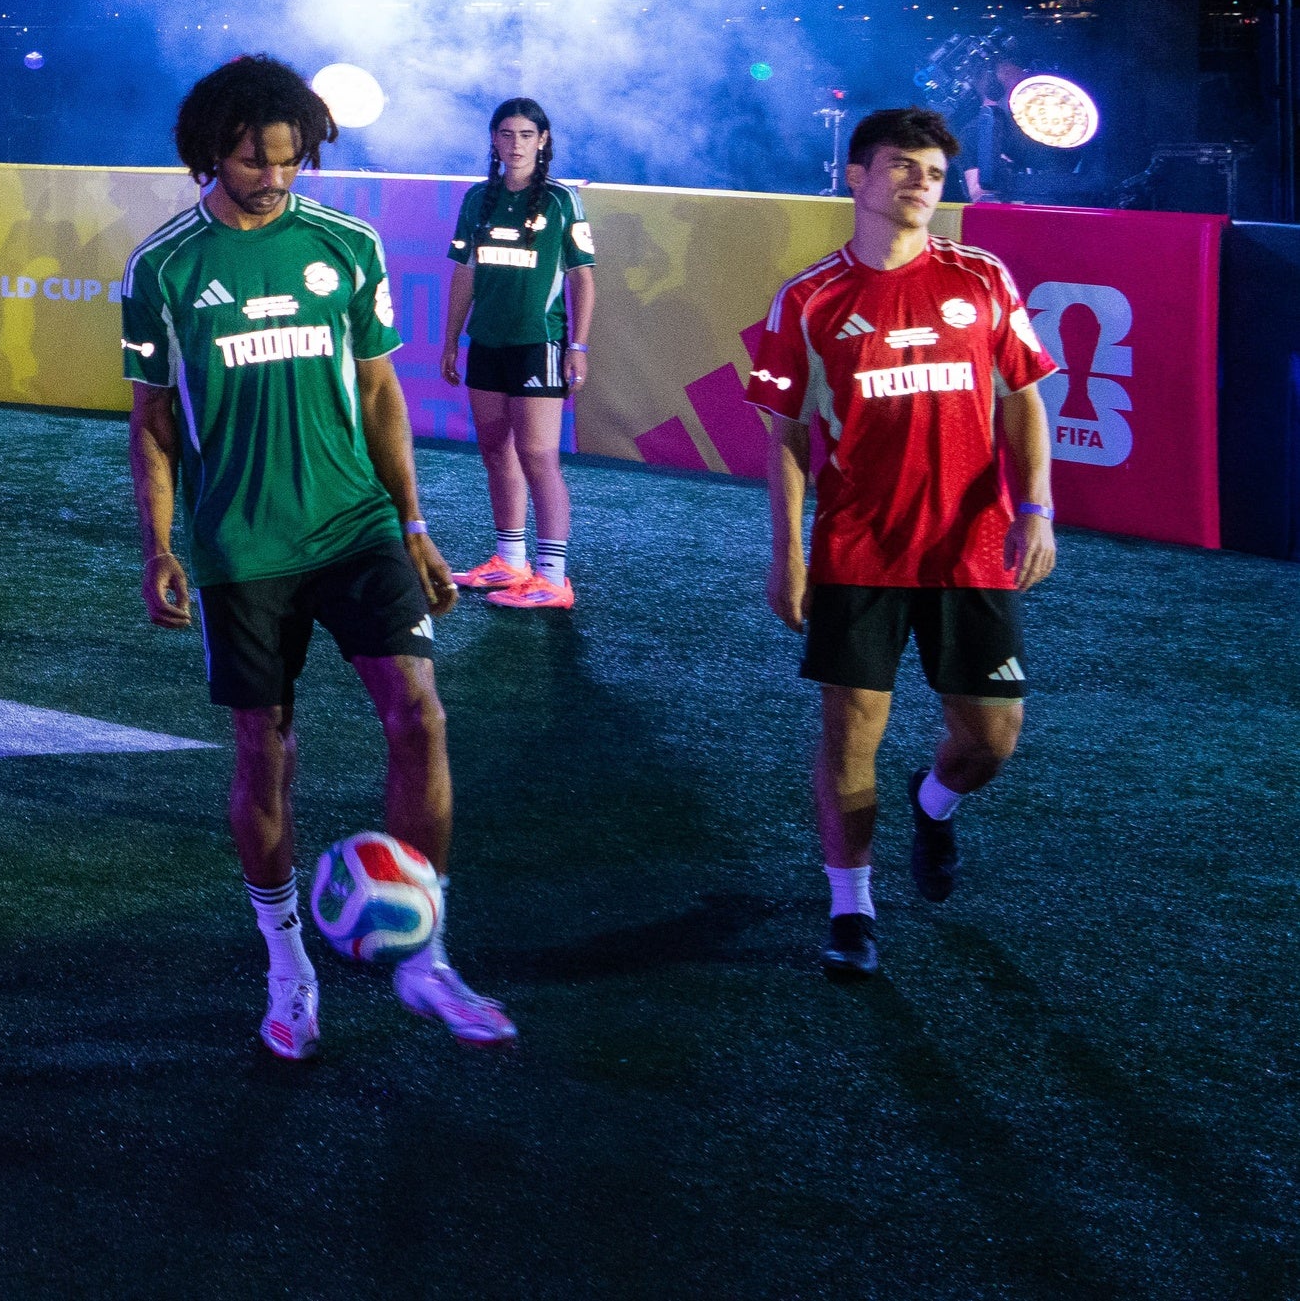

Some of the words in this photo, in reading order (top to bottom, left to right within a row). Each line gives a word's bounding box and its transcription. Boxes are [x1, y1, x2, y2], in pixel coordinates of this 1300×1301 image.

[43, 277, 103, 301] CUP
[214, 325, 334, 368] TRIONDA
[852, 361, 975, 399] TRIONDA
[1056, 425, 1104, 450] FIFA
